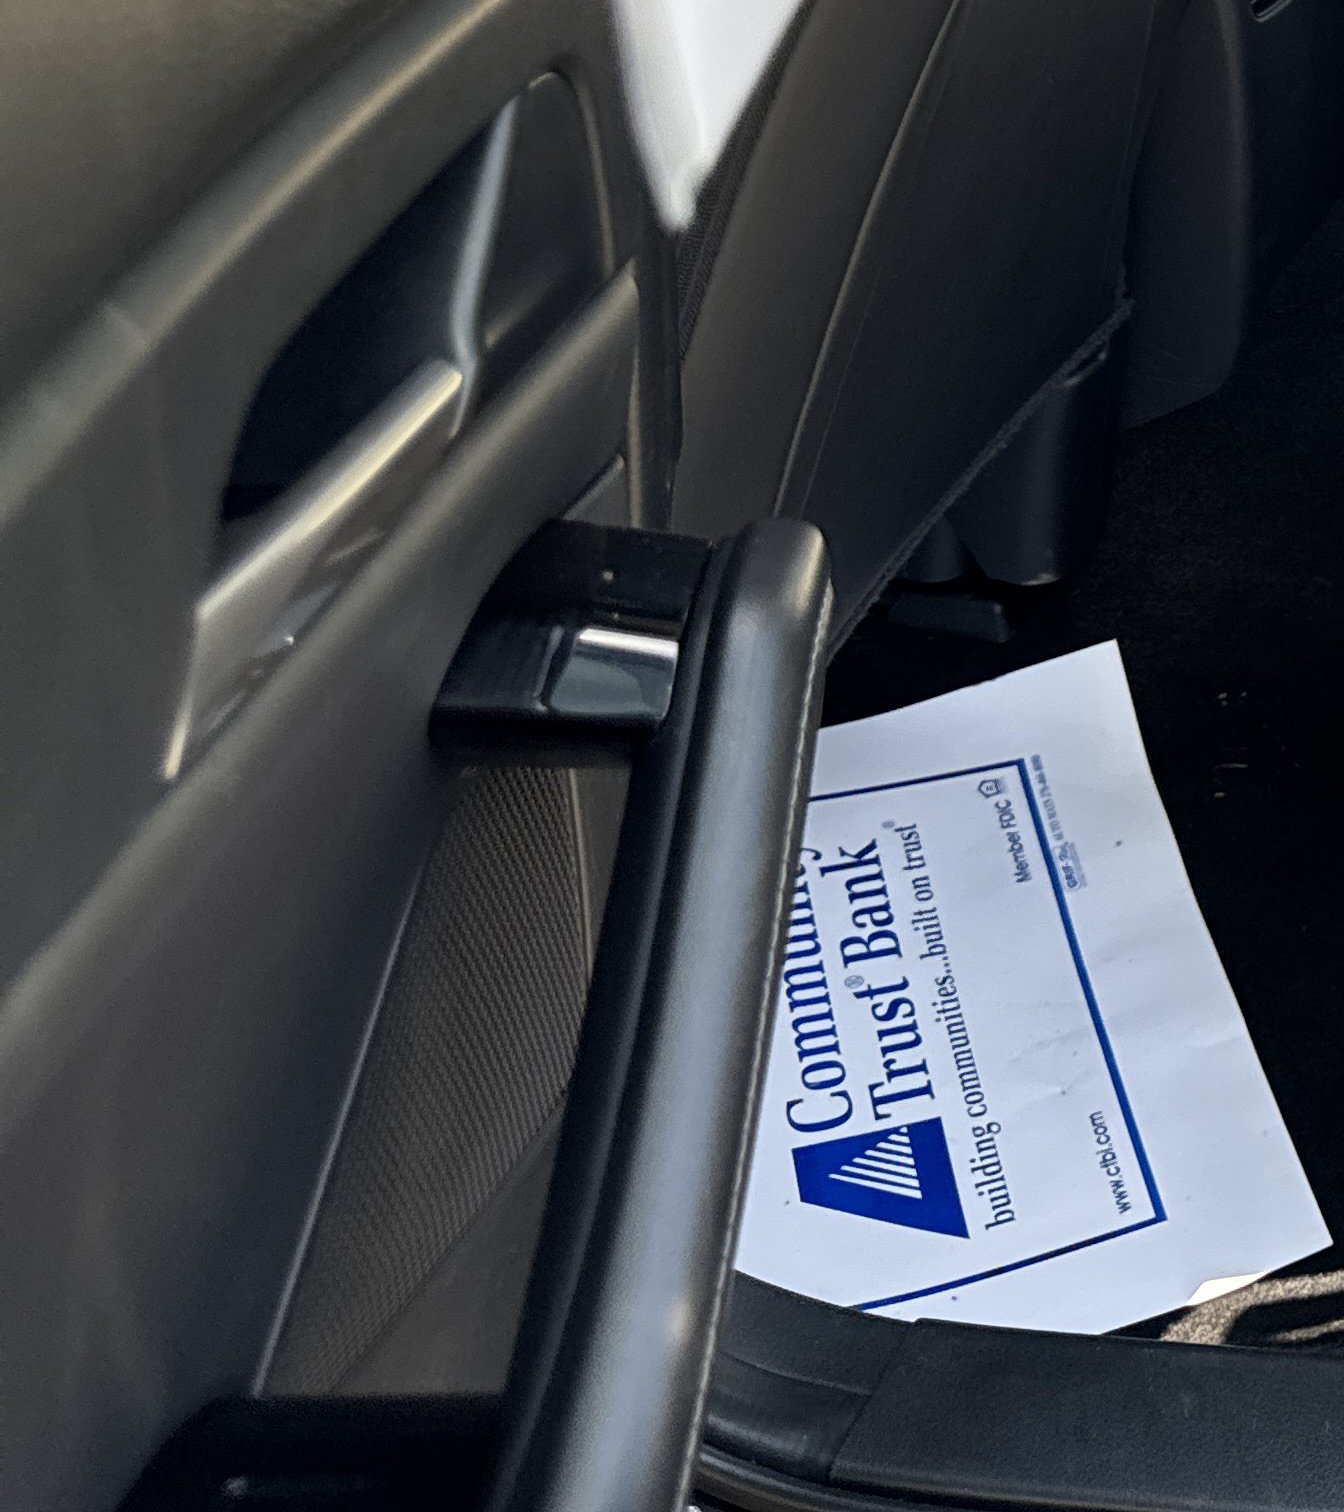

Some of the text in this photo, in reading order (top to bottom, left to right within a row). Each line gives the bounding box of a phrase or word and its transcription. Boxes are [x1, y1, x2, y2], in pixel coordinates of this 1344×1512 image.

[911, 875, 934, 902] on
[994, 799, 1032, 883] Member FDIC
[819, 838, 903, 968] Bank
[783, 847, 853, 1133] Commun
[969, 1121, 1016, 1231] building
